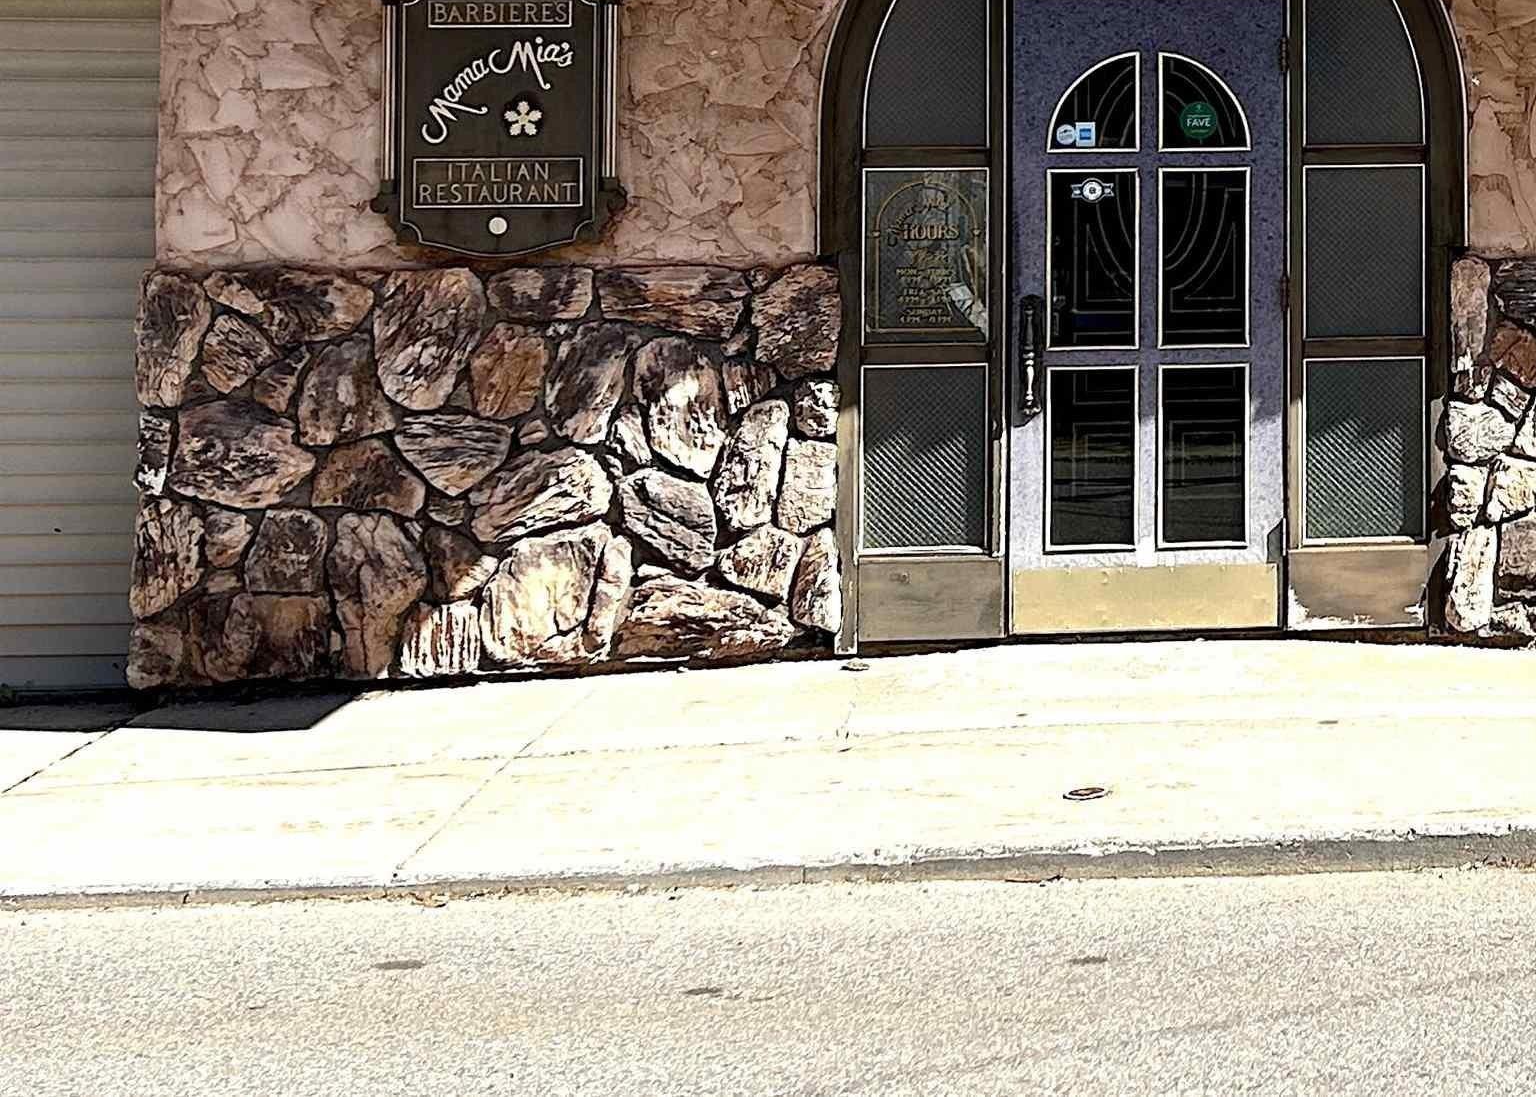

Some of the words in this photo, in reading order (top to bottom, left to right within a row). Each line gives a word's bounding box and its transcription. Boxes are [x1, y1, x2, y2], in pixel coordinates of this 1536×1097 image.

[421, 58, 490, 144] Mama
[488, 36, 574, 90] Mia's
[1186, 118, 1211, 127] FAVE
[448, 162, 549, 181] ITALIAN
[419, 182, 577, 203] RESTAURANT
[903, 222, 959, 241] HOURS
